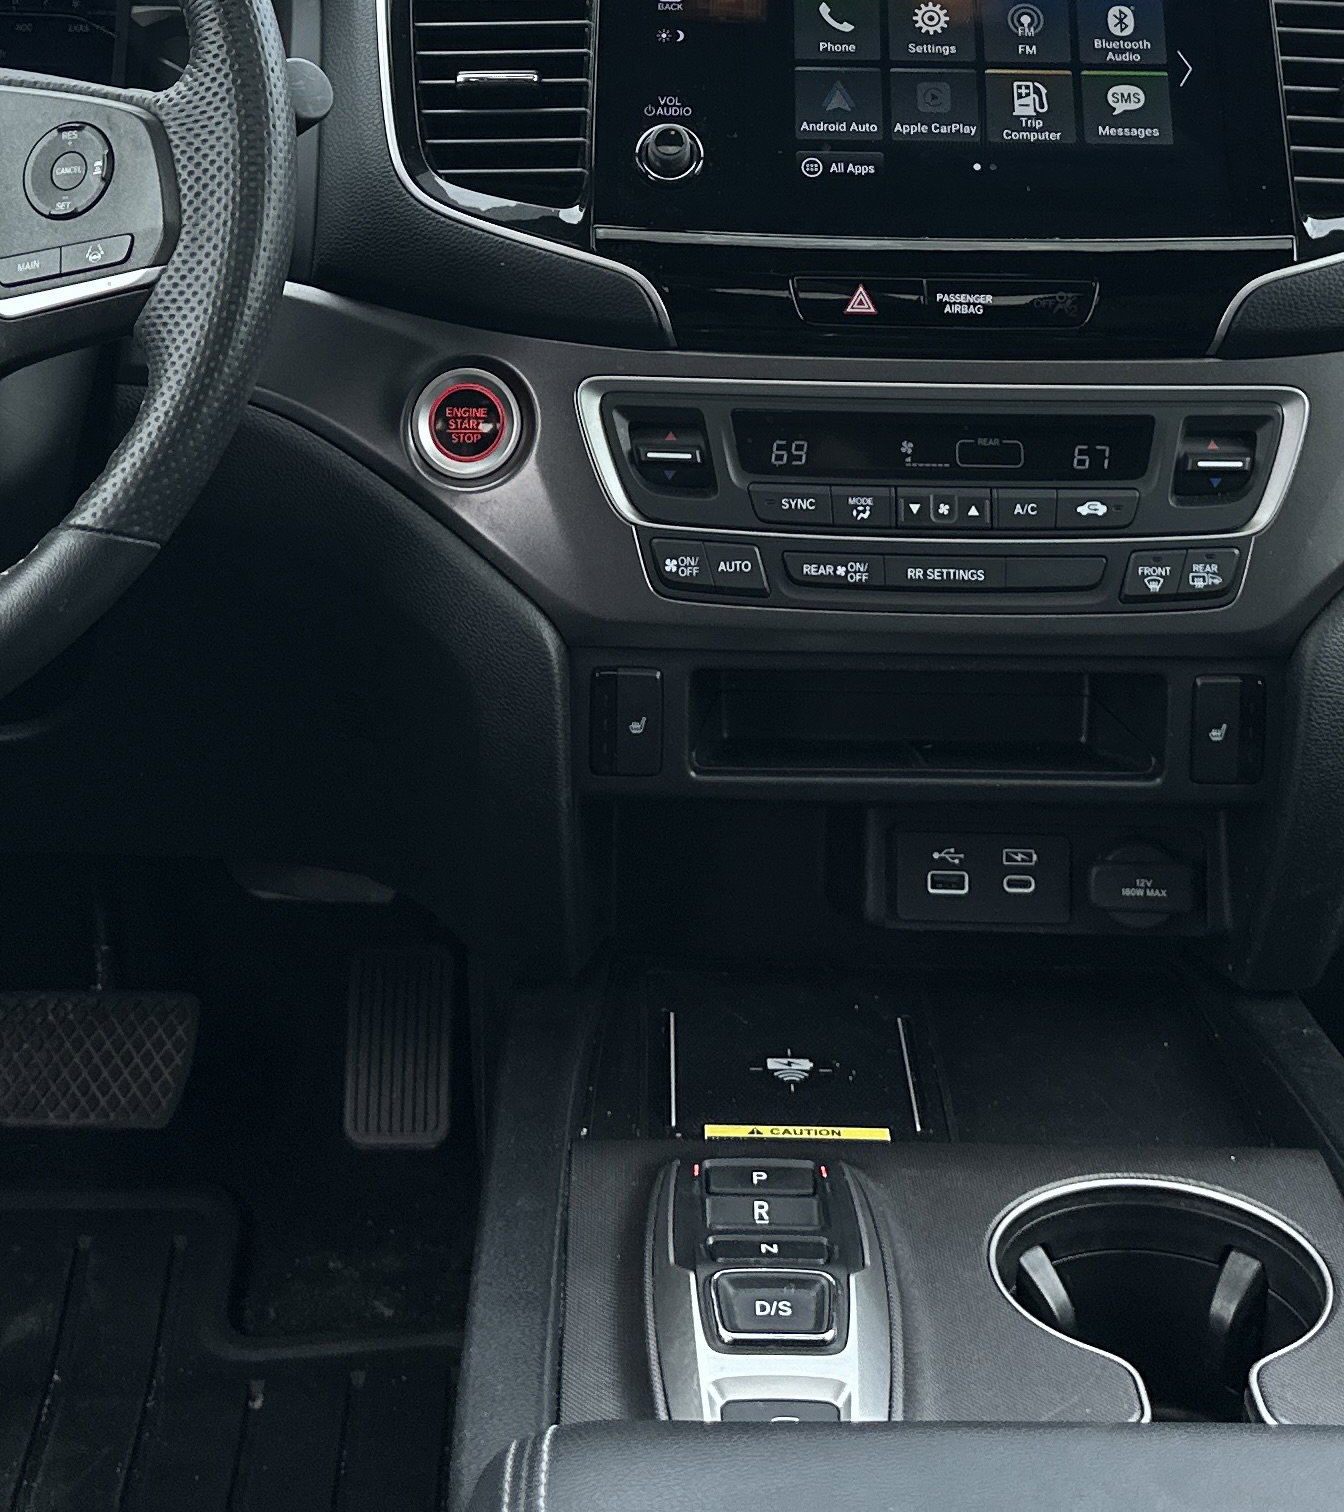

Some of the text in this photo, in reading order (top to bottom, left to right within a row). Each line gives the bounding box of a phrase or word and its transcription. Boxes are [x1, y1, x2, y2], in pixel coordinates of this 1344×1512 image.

[657, 3, 684, 12] BACK
[819, 41, 857, 53] Phone
[908, 42, 957, 56] Settings
[1018, 44, 1037, 55] FM
[1093, 38, 1152, 50] Bluetooth
[1106, 51, 1141, 62] Audio
[658, 96, 682, 107] VOL
[1111, 91, 1141, 104] SMS
[656, 106, 692, 117] AUDIO
[800, 121, 878, 133] Android Auto
[893, 121, 977, 136] Apple CarPlay
[1020, 116, 1043, 129] Trip
[61, 130, 78, 140] RES
[1002, 129, 1062, 143] Computer
[1097, 124, 1160, 139] Messages
[55, 166, 83, 175] CANCEL
[829, 161, 875, 176] All Apps
[55, 200, 71, 210] SET
[17, 260, 40, 272] MAIN
[936, 293, 994, 305] PASSENGER
[944, 304, 984, 315] AIRBAG
[445, 406, 488, 418] ENGINE
[451, 433, 482, 444] STOP
[977, 437, 1000, 446] REAR
[771, 440, 808, 465] 69
[1072, 445, 1110, 470] 67
[781, 498, 816, 511] SYNC
[848, 496, 874, 506] MODE
[1013, 503, 1038, 516] A/C
[678, 556, 699, 567] ON/
[717, 560, 752, 573] AUTO
[847, 561, 869, 572] ON/
[678, 566, 700, 578] OFF
[802, 564, 834, 577] REAR
[907, 567, 986, 581] RR SETTINGS
[1138, 566, 1172, 577] FRONT
[1192, 563, 1218, 573] REAR
[847, 571, 869, 583] OFF
[1135, 878, 1153, 888] 12V
[1146, 888, 1167, 897] MAX
[769, 1127, 842, 1137] CAUTION
[752, 1171, 768, 1184] P
[753, 1200, 770, 1222] R
[760, 1243, 779, 1254] N
[755, 1300, 793, 1317] D/S
